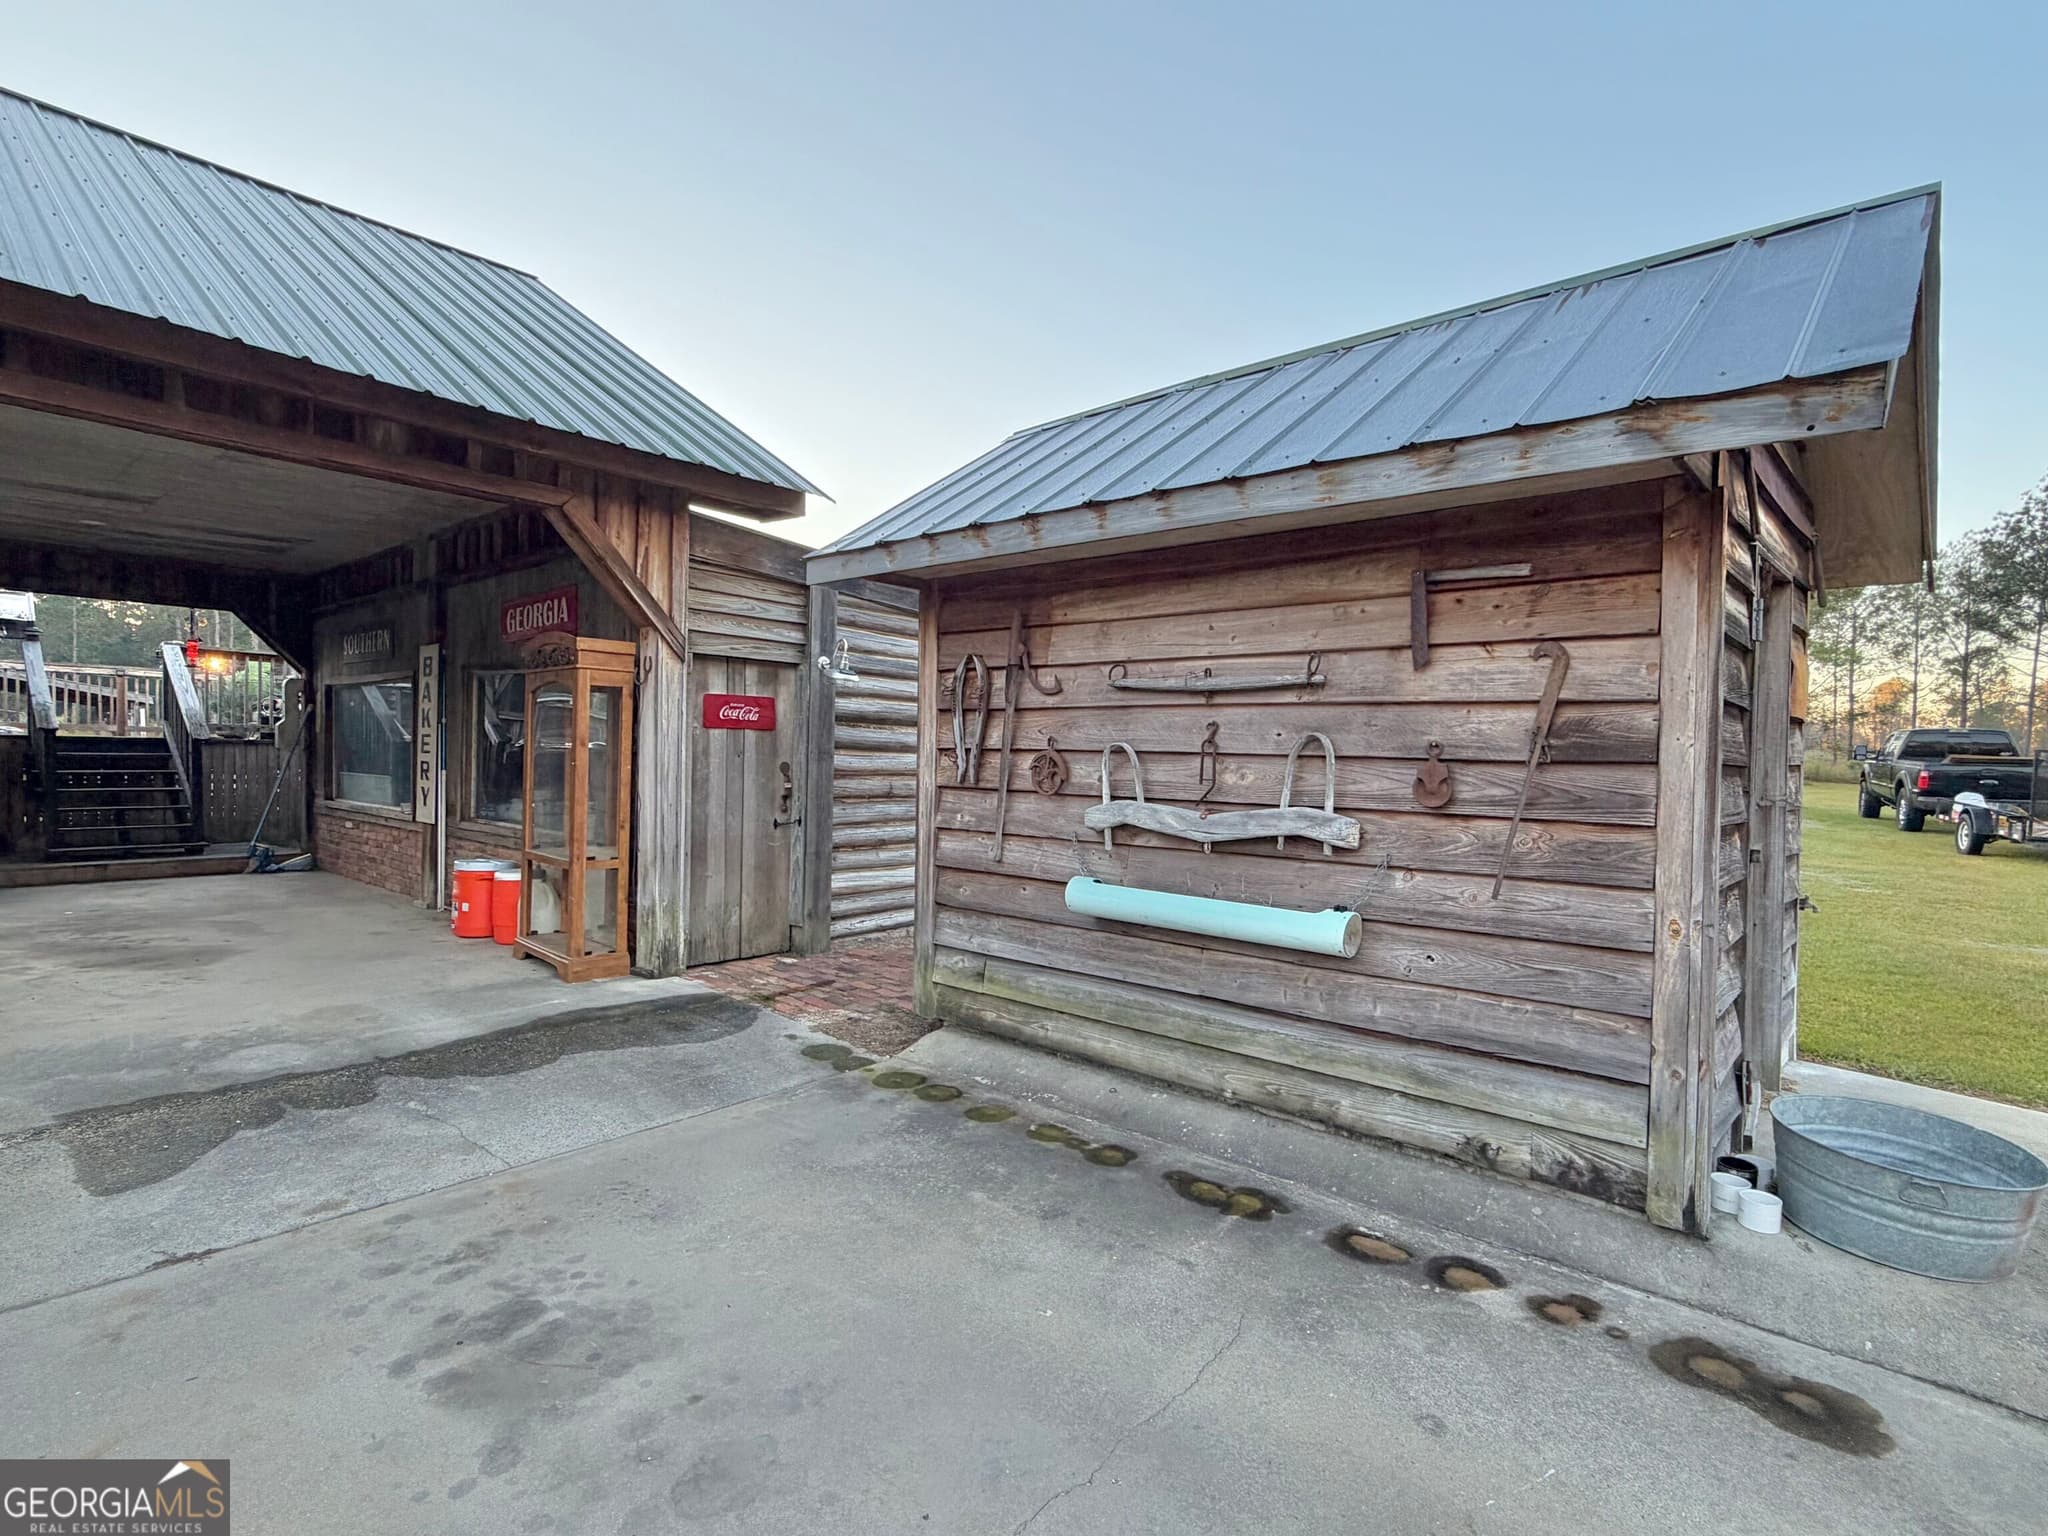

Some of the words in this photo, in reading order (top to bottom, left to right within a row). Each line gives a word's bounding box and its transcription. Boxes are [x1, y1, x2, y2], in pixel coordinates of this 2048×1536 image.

[506, 597, 569, 633] GEORGIA
[343, 629, 390, 655] SOUTHERN
[419, 655, 432, 807] BAKERY
